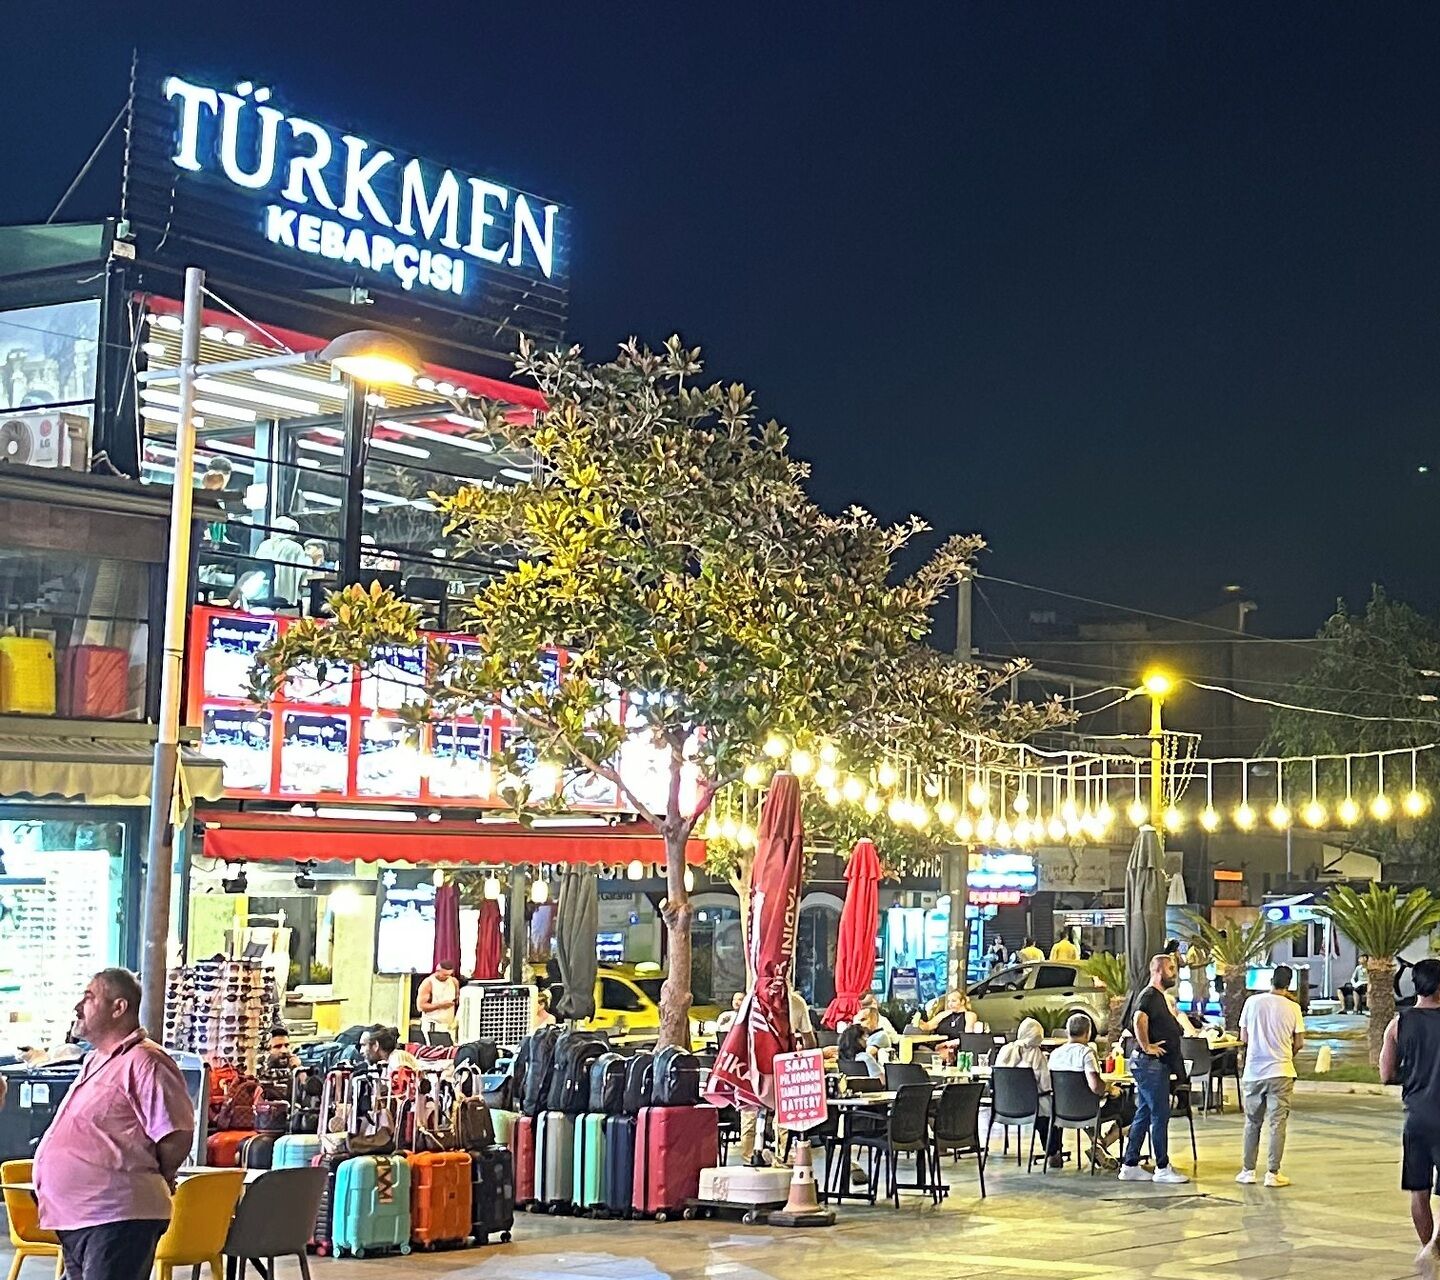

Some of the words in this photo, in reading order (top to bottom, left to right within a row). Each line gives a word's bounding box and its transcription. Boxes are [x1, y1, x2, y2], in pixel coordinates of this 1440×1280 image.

[165, 75, 560, 279] TÜRKMEN
[265, 203, 465, 295] KEBAPÇISI
[40, 438, 51, 449] LG
[781, 885, 797, 954] TADINI
[785, 1057, 814, 1072] SAAT
[781, 1096, 821, 1112] BATTERY
